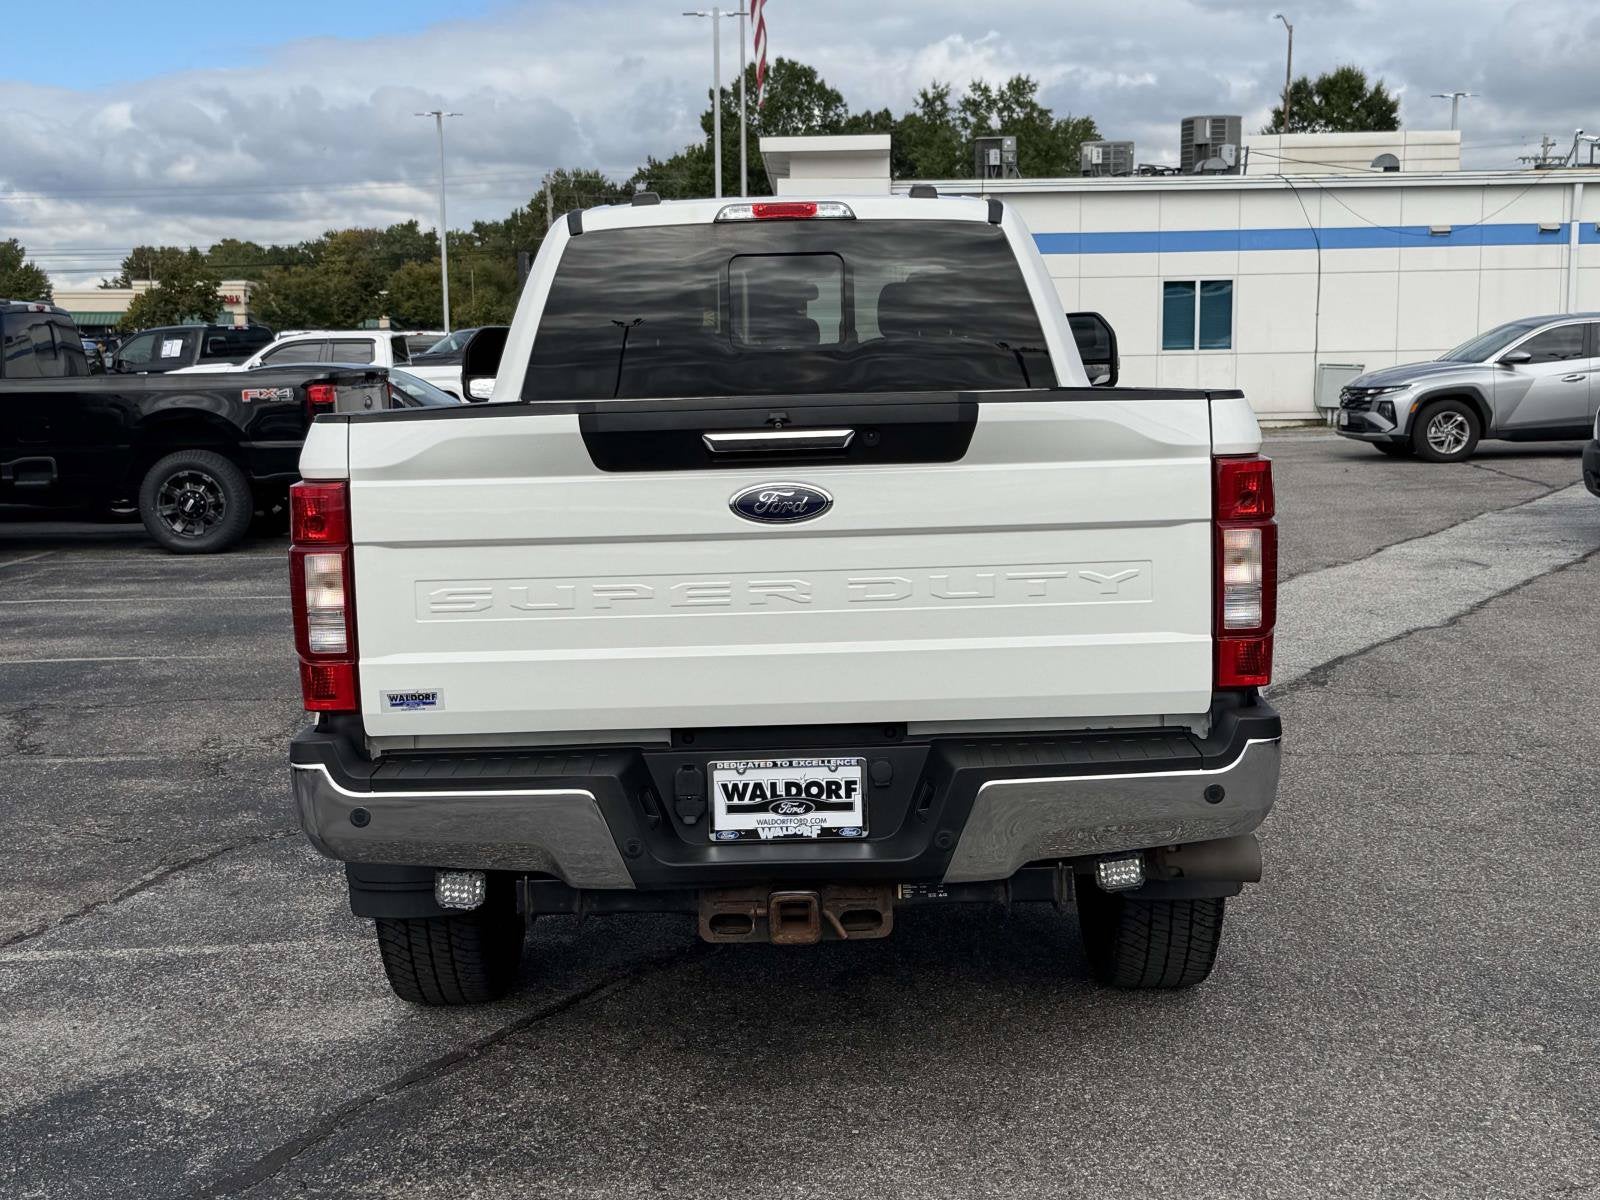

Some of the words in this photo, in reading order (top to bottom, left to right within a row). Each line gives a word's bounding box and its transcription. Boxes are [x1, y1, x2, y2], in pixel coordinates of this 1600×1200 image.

[241, 388, 294, 402] FX4
[753, 491, 808, 513] Ford
[428, 579, 812, 613] SUPER
[847, 569, 1139, 602] DUTY
[387, 692, 438, 702] WALDORF
[716, 761, 773, 769] DEDICATED
[792, 759, 858, 767] EXCELLENCE
[718, 779, 858, 802] WALDORF
[778, 802, 806, 814] Ford
[756, 817, 828, 826] WALDORFFORD.COM
[757, 825, 821, 839] WALDORF
